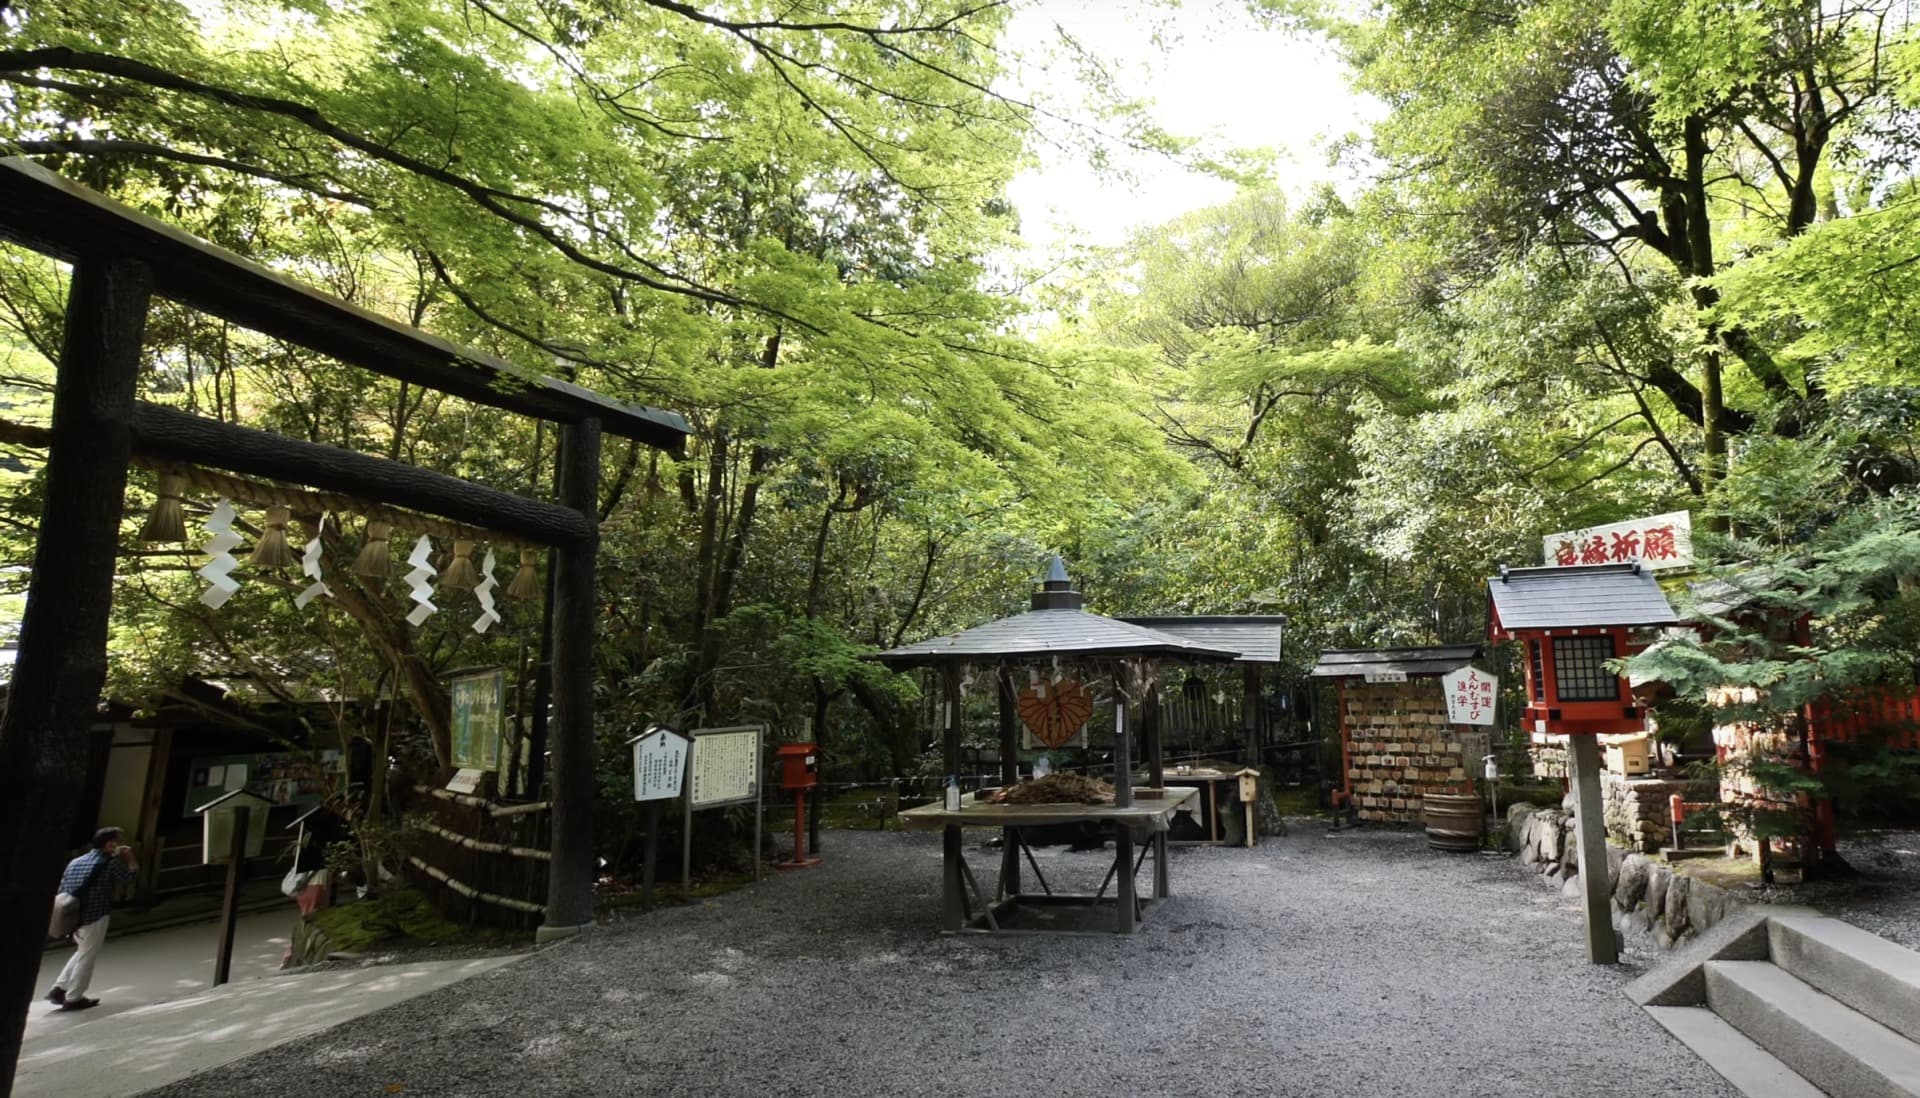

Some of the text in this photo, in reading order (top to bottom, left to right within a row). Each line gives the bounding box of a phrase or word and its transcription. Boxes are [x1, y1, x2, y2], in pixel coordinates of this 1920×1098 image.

[1457, 680, 1468, 707] 進学
[1469, 671, 1480, 720] えんむすび
[1481, 682, 1492, 708] 開運
